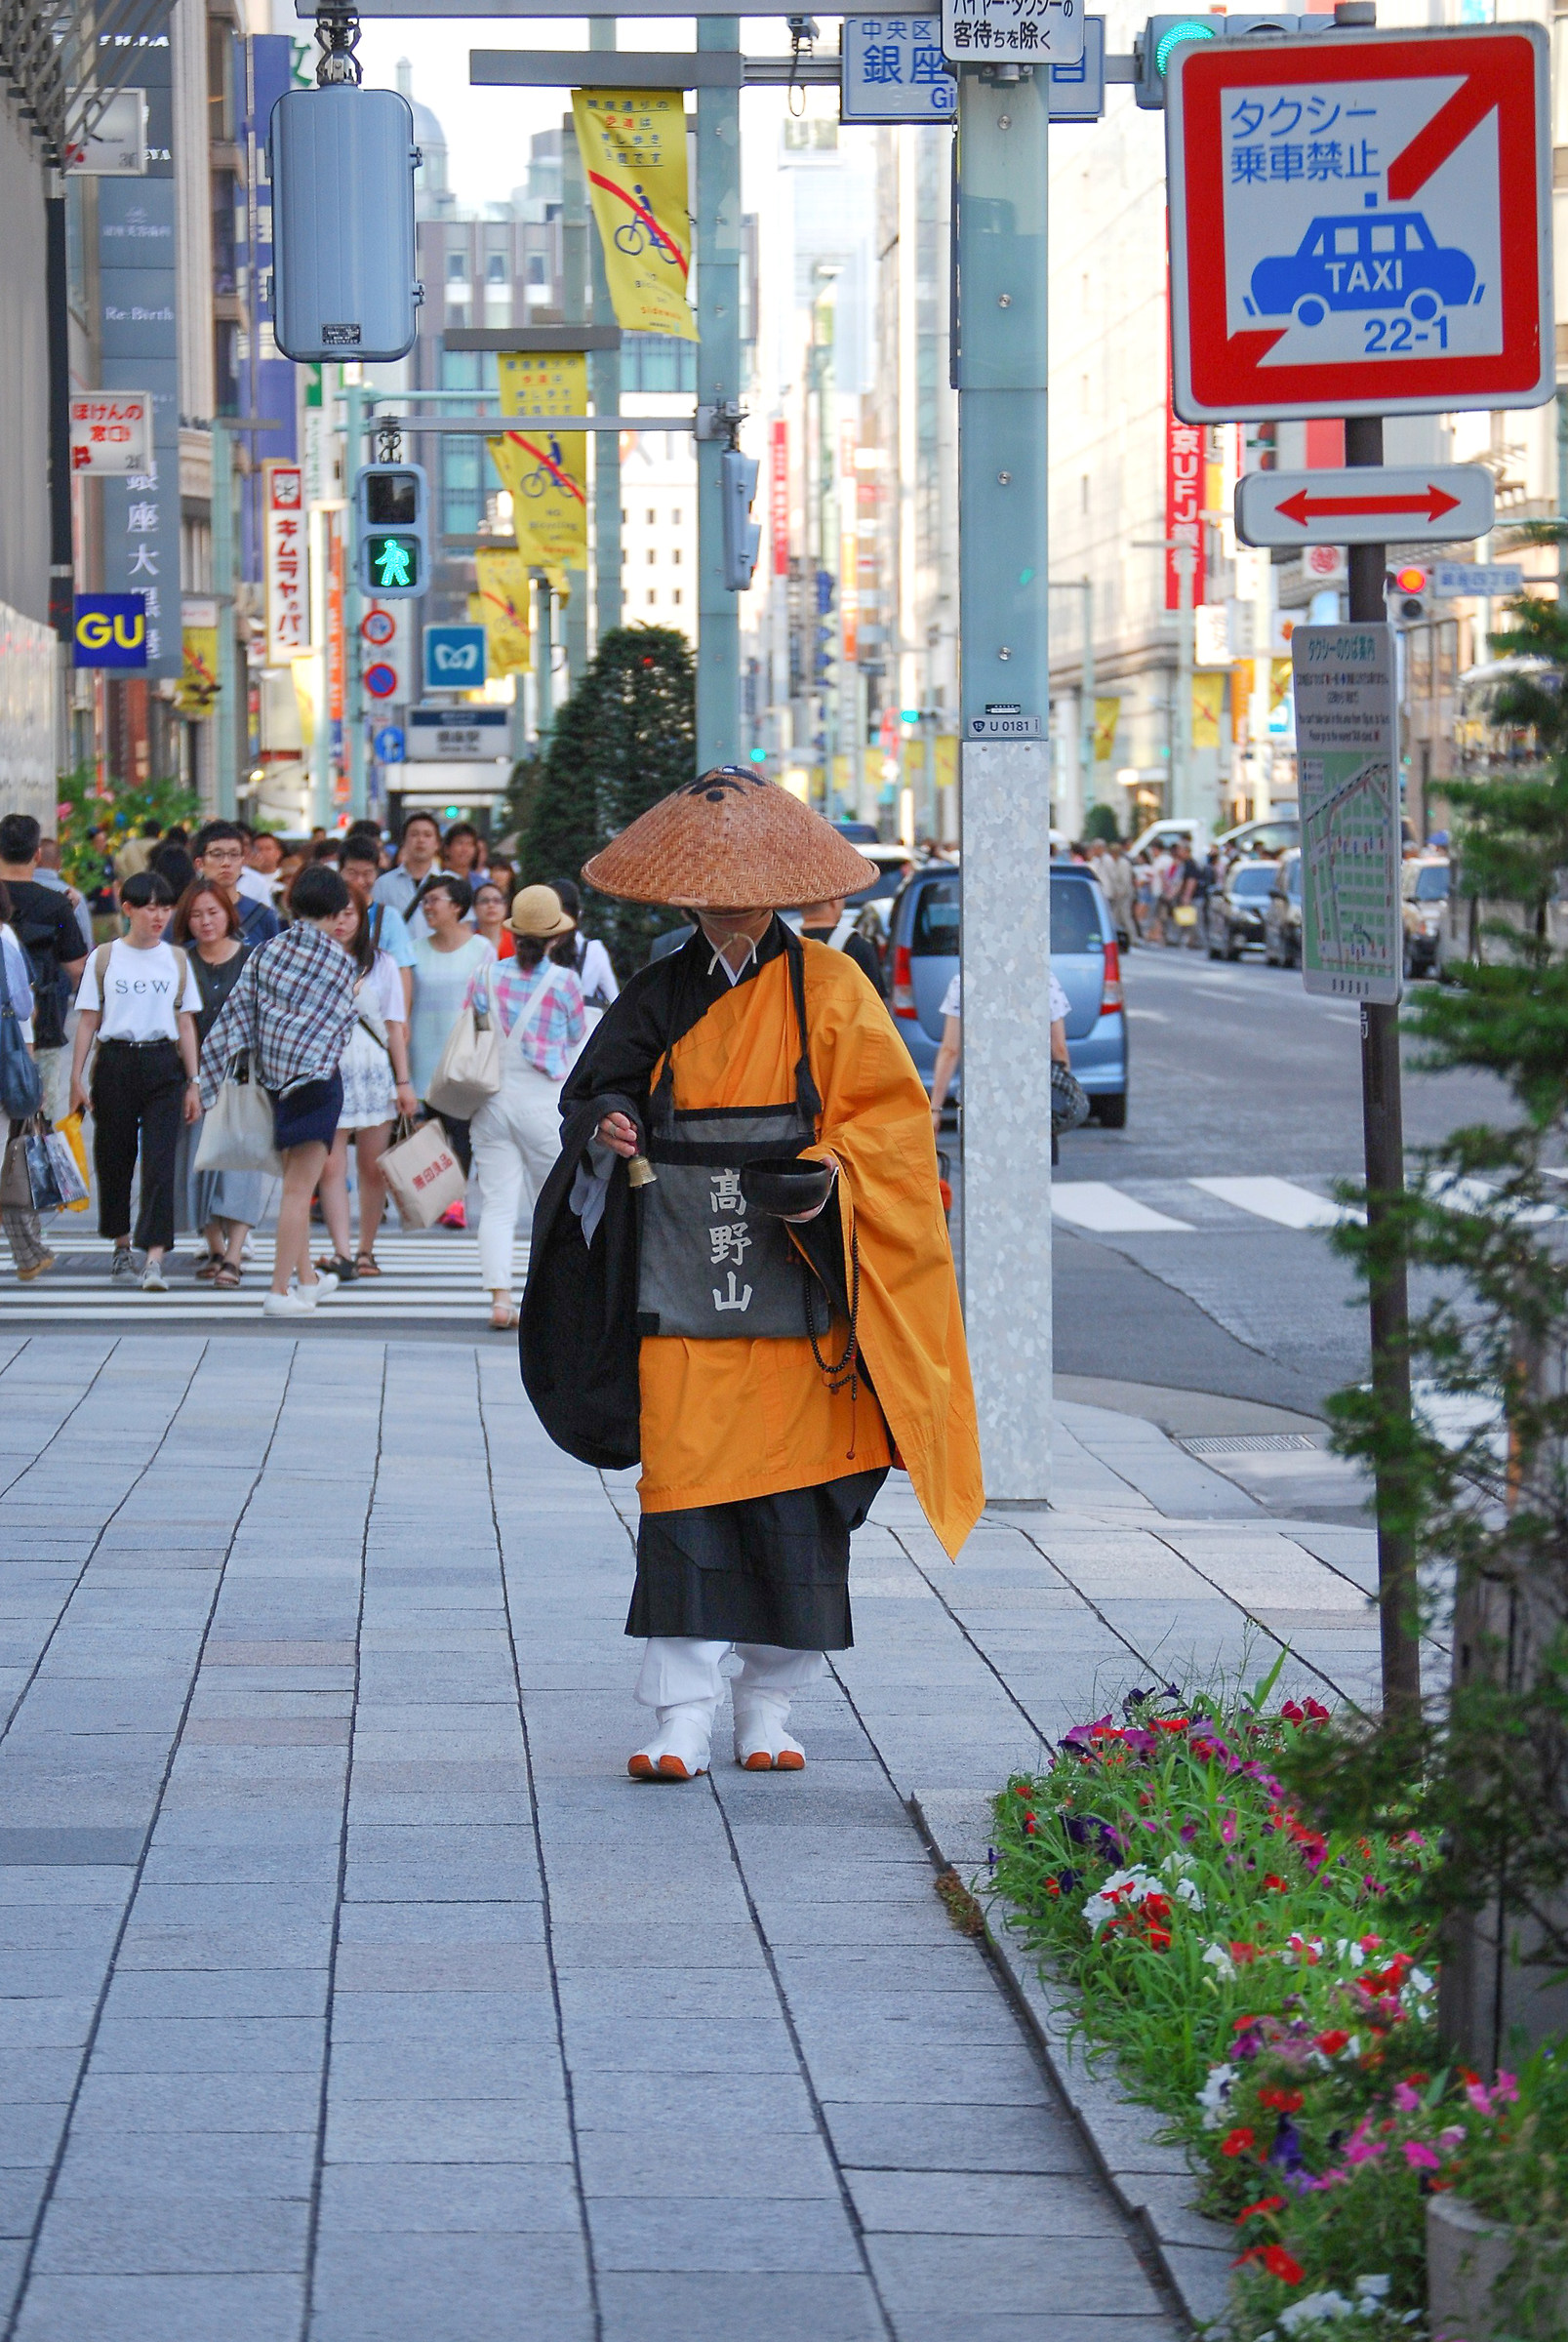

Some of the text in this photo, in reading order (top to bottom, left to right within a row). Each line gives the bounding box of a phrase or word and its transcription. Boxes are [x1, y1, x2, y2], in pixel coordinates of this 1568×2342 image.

[862, 20, 933, 41] 中央区
[953, 20, 1051, 51] 客待ちを除く
[1230, 96, 1378, 140] タクシー
[1230, 140, 1381, 184] 乗車禁止
[1324, 259, 1403, 294] TAXI
[1364, 318, 1449, 353] 22-1
[1170, 423, 1201, 577] 京UFJ銀行
[75, 612, 145, 650] GU
[1002, 721, 1029, 732] 0181
[115, 979, 171, 994] sew
